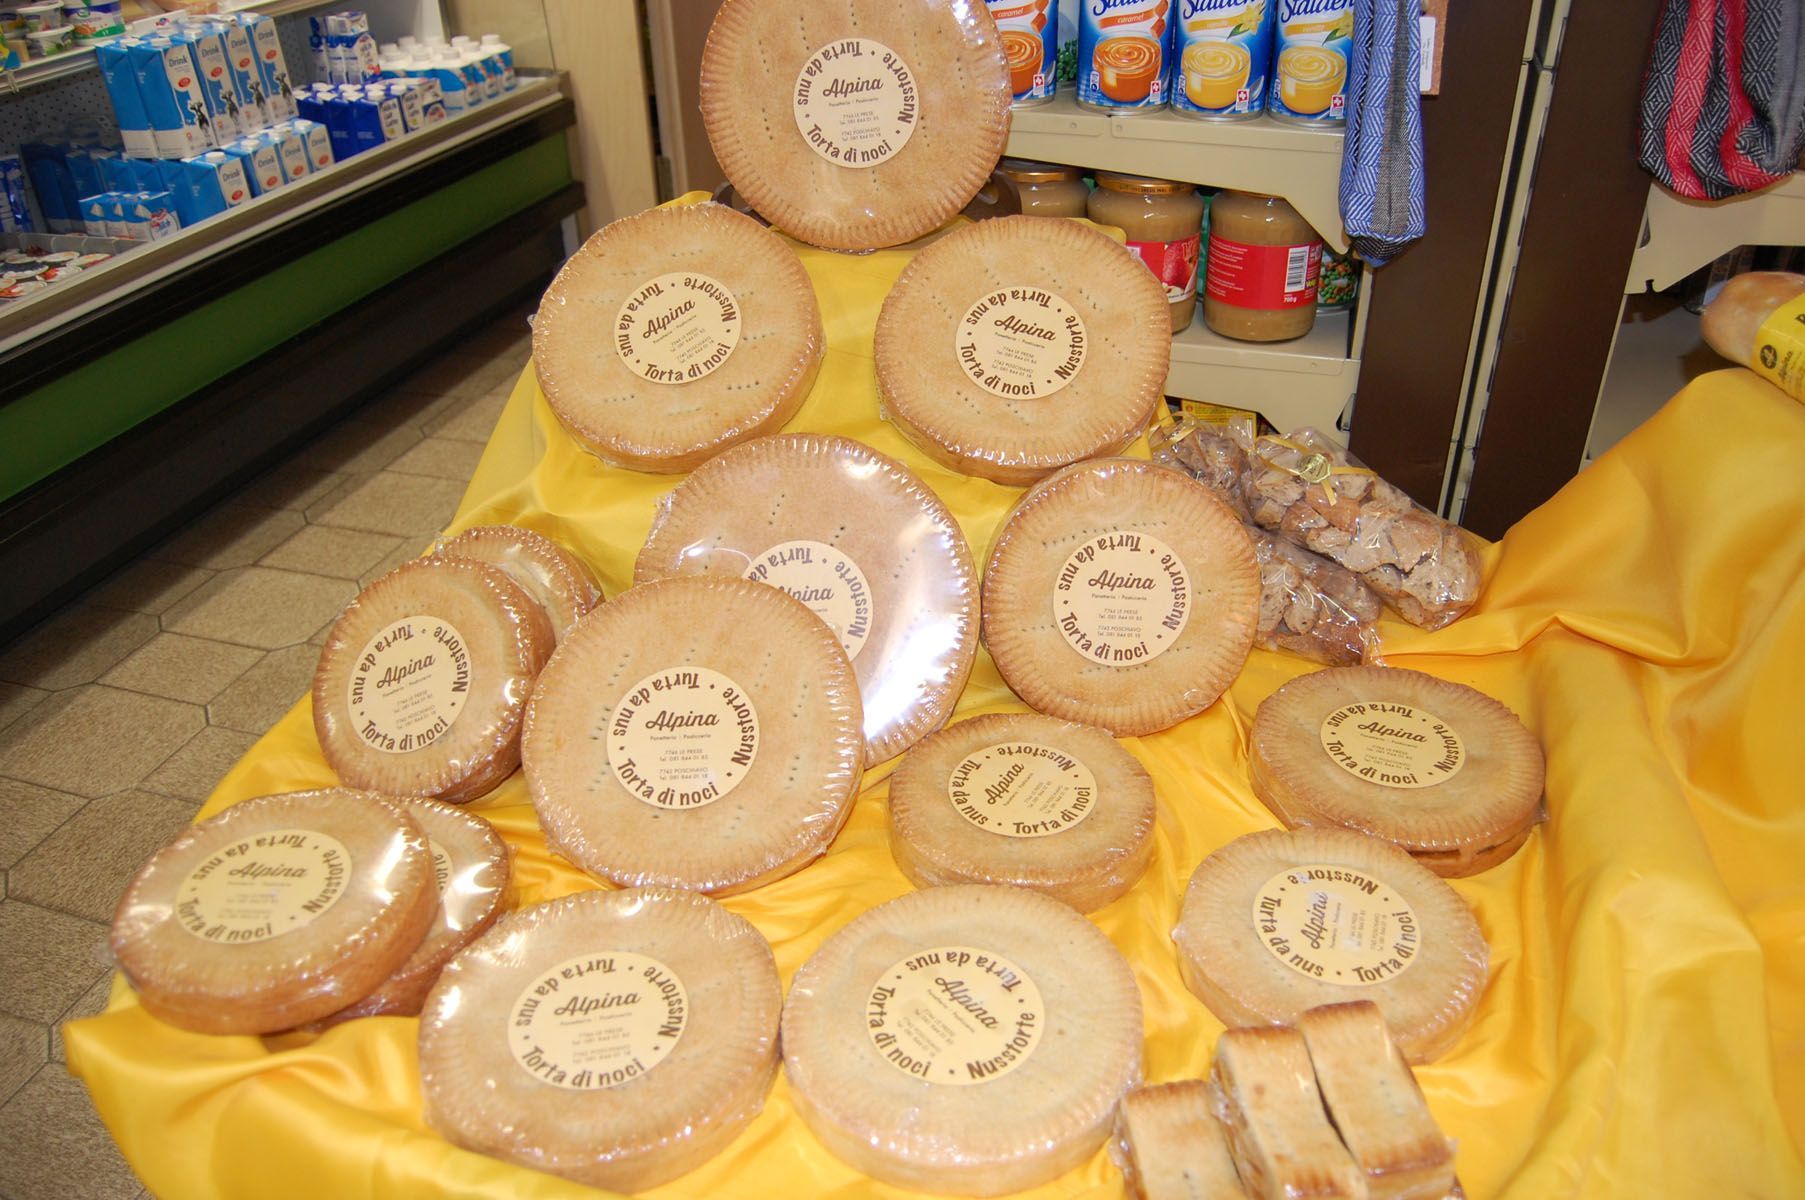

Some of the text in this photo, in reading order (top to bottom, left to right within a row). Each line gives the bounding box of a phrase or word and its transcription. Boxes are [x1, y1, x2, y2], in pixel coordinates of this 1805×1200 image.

[258, 30, 274, 40] Drink
[998, 8, 1024, 18] caramel
[1117, 13, 1145, 24] caramel
[168, 56, 188, 67] Drink
[201, 46, 219, 57] Drink
[231, 38, 247, 48] Drink
[797, 41, 863, 105] Turta da nus
[822, 77, 883, 98] Alpina
[882, 52, 915, 124] Nusstorte
[807, 124, 893, 163] Torta di noci
[222, 169, 240, 182] Drink
[618, 283, 664, 358] Turta da nus
[642, 299, 696, 339] Alpina
[684, 277, 737, 323] Nusstorte
[966, 289, 1051, 325] Turta da nus
[994, 315, 1056, 341] Alpina
[1053, 315, 1084, 380] Nusstorte
[644, 342, 731, 381] Torta di noci
[961, 342, 1036, 396] Torta di noci
[767, 547, 813, 567] Turta
[1058, 534, 1141, 591] Turta da nus
[834, 561, 869, 639] Nusstorte
[1088, 569, 1156, 592] Alpina
[1161, 554, 1187, 631] Nusstorte
[433, 626, 469, 692] Nusstorte
[1061, 612, 1149, 661] Torta di noci
[352, 624, 414, 705] Turta da nus
[376, 654, 437, 689] Alpina
[613, 672, 700, 736] Turta da nus
[645, 710, 720, 732] Alpina
[1327, 703, 1413, 728] Turta da nus
[361, 716, 449, 751] Torta di noci
[722, 687, 755, 767] Nusstorte
[1357, 721, 1428, 743] Alpina
[1433, 724, 1460, 773] Nusstorte
[997, 745, 1076, 772] Nusstorte
[1326, 740, 1419, 785] Torta di noci
[617, 758, 719, 806] Torta di noci
[952, 759, 989, 825] Turta da nus
[984, 762, 1025, 805] Alpina
[1013, 786, 1091, 834] Torta di noci
[192, 834, 307, 881] Turta da nus
[229, 861, 308, 880] Alpina
[301, 849, 344, 914] Nusstorte
[178, 897, 207, 932] Torta
[204, 924, 228, 940] di
[227, 922, 273, 941] noci
[1259, 896, 1325, 977] Turta da nus
[1352, 911, 1416, 983] Torta di noci
[515, 958, 616, 1027] Turta da nus
[905, 951, 1022, 993] Turta da nus
[553, 992, 642, 1017] Alpina
[643, 966, 684, 1039] Nusstorte
[934, 977, 999, 1030] Alpina
[869, 986, 932, 1078] Torta di noci
[966, 1012, 1036, 1080] Nusstorte
[521, 1045, 646, 1088] Torta di noci
